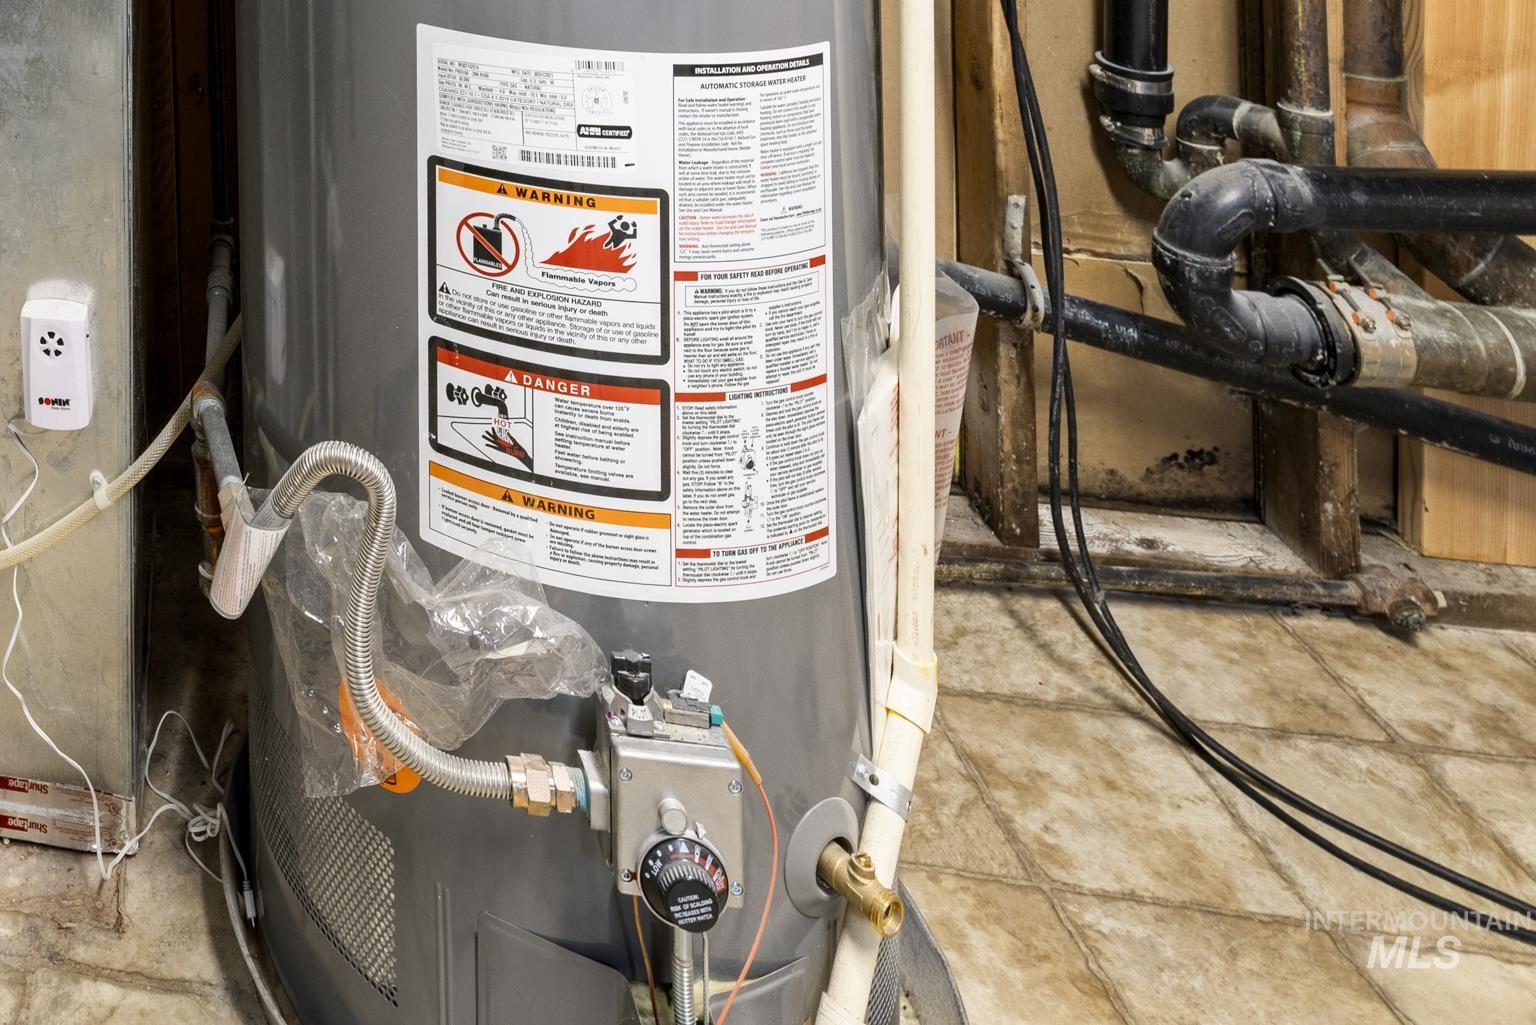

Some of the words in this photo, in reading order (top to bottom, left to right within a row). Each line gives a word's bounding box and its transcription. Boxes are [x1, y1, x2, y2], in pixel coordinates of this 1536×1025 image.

[694, 67, 741, 75] INSTALLATION
[756, 61, 789, 72] OPERATION
[789, 59, 810, 68] DETAILS
[700, 82, 738, 90] AUTOMATIC
[739, 80, 767, 89] STORAGE
[767, 78, 786, 87] WATER
[786, 75, 807, 84] HEATER
[602, 129, 630, 137] CERTIFIED
[515, 187, 596, 208] WARNING
[473, 256, 503, 270] FLAMMABLES
[729, 271, 749, 280] SAFETY
[765, 267, 783, 276] BEFORE
[784, 262, 809, 274] OPERATING
[541, 271, 586, 285] Flammable
[588, 278, 616, 288] Vapors
[486, 289, 500, 298] Can
[501, 294, 520, 303] result
[530, 300, 556, 310] serious
[558, 304, 578, 314] injury
[588, 308, 608, 317] death
[492, 282, 508, 292] FIRE
[510, 287, 526, 296] AND
[527, 290, 569, 303] EXPLOSION
[572, 298, 602, 308] HAZARD
[473, 296, 489, 305] store
[510, 306, 538, 316] gasoline
[546, 312, 563, 320] other
[564, 314, 598, 325] flammable
[599, 320, 621, 328] vapors
[635, 322, 656, 331] liquids
[522, 374, 591, 397] DANGER
[728, 393, 753, 401] LIGHTING
[754, 387, 789, 398] INSTRUCTIONS
[493, 418, 512, 429] HOT
[505, 446, 525, 459] BURN
[521, 495, 596, 520] WARNING
[749, 547, 759, 555] OFF
[768, 544, 777, 552] THE
[778, 538, 803, 550] APPLIANCE
[8, 776, 49, 795] Shurtape
[8, 816, 48, 834] Shurtape
[651, 859, 663, 876] LOW
[670, 905, 682, 913] RISK
[689, 898, 713, 908] SCALDING
[673, 909, 700, 919] INCREASES
[678, 917, 696, 925] HOTTER
[696, 913, 713, 921] WATER
